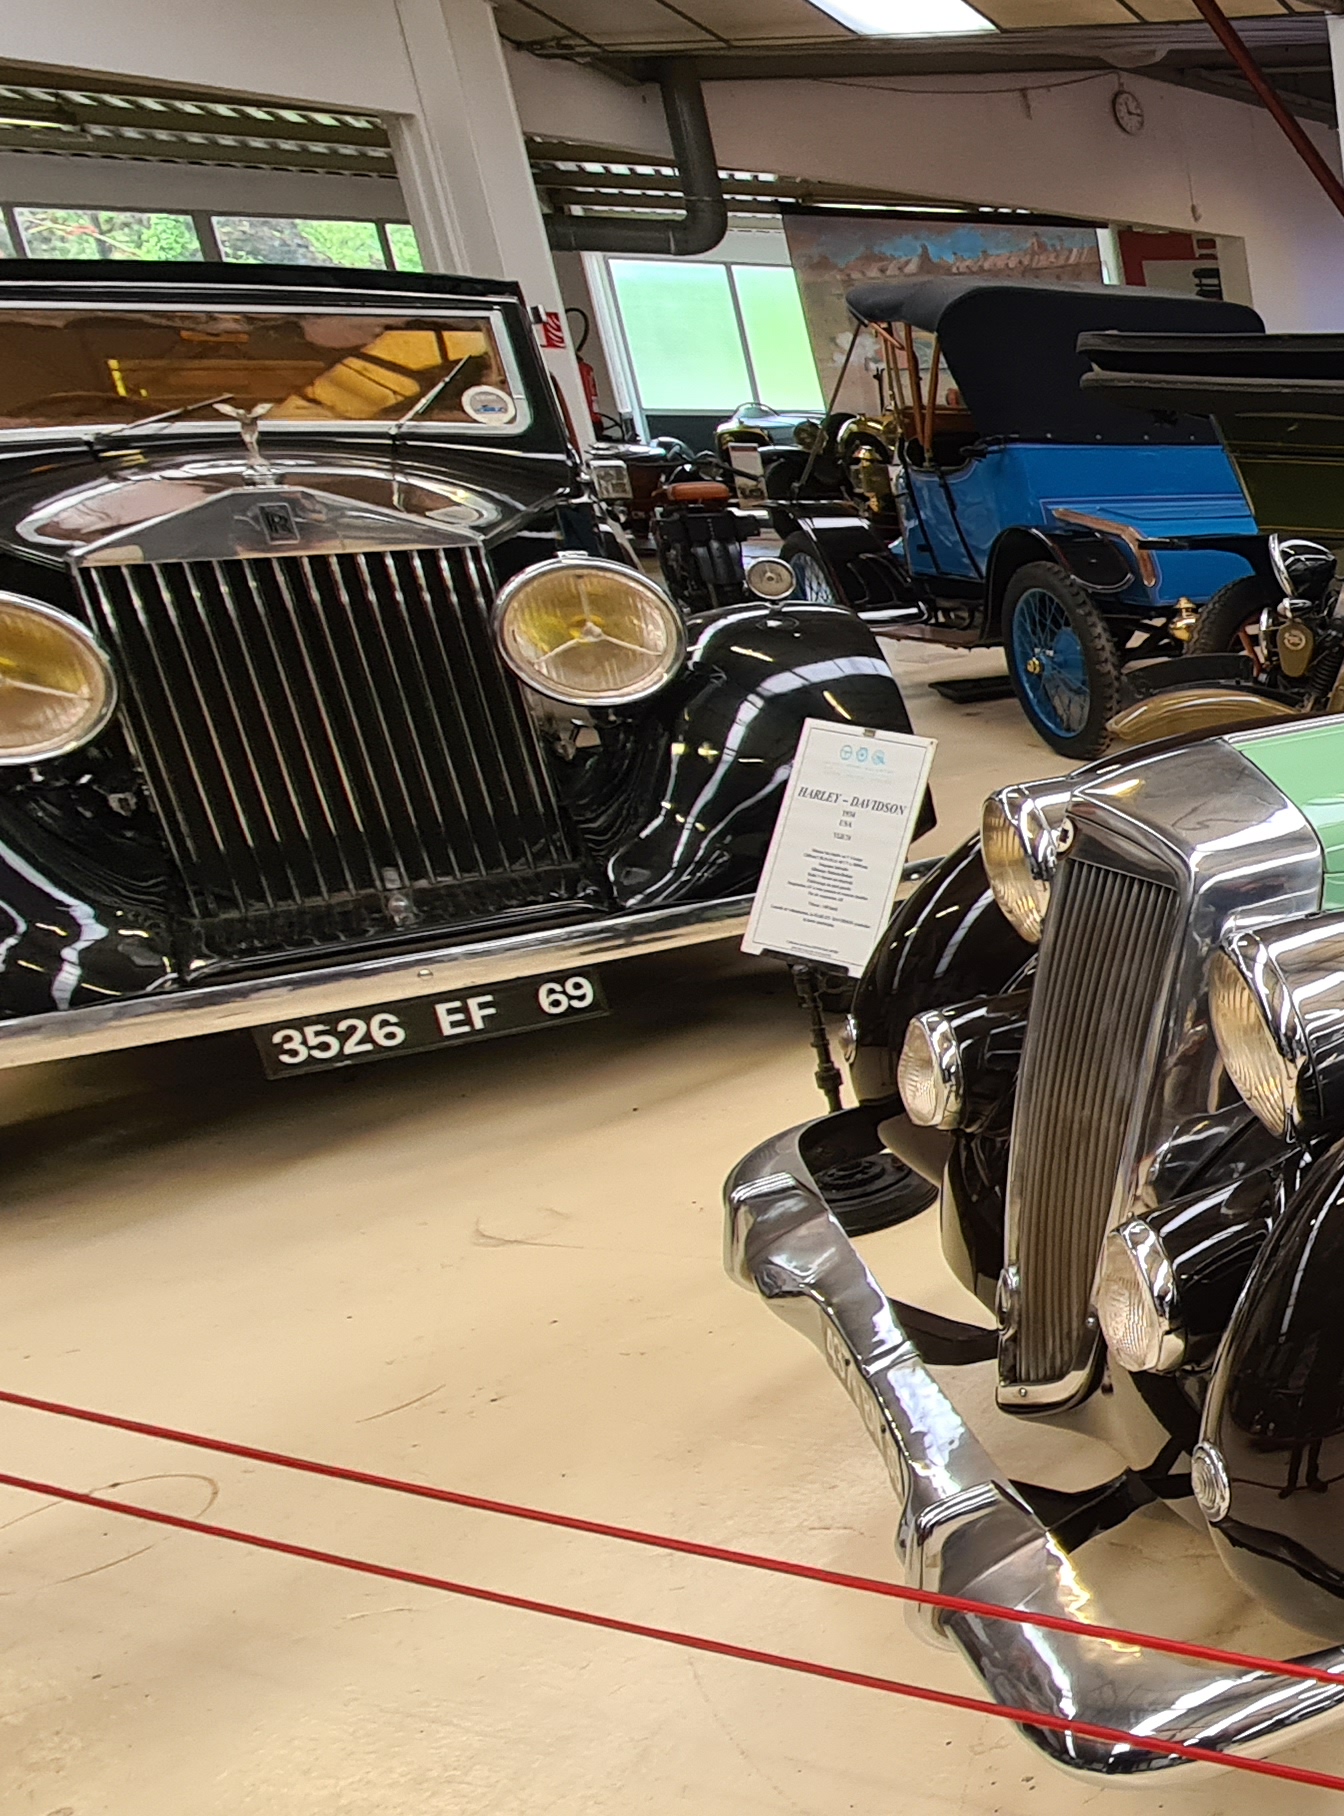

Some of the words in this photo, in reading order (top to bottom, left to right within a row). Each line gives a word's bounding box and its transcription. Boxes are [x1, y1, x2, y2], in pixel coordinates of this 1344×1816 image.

[798, 787, 841, 803] HARLEY
[850, 796, 907, 815] DAVIDSON
[271, 1013, 406, 1064] 3526
[434, 995, 497, 1036] EF
[537, 976, 594, 1014] 69
